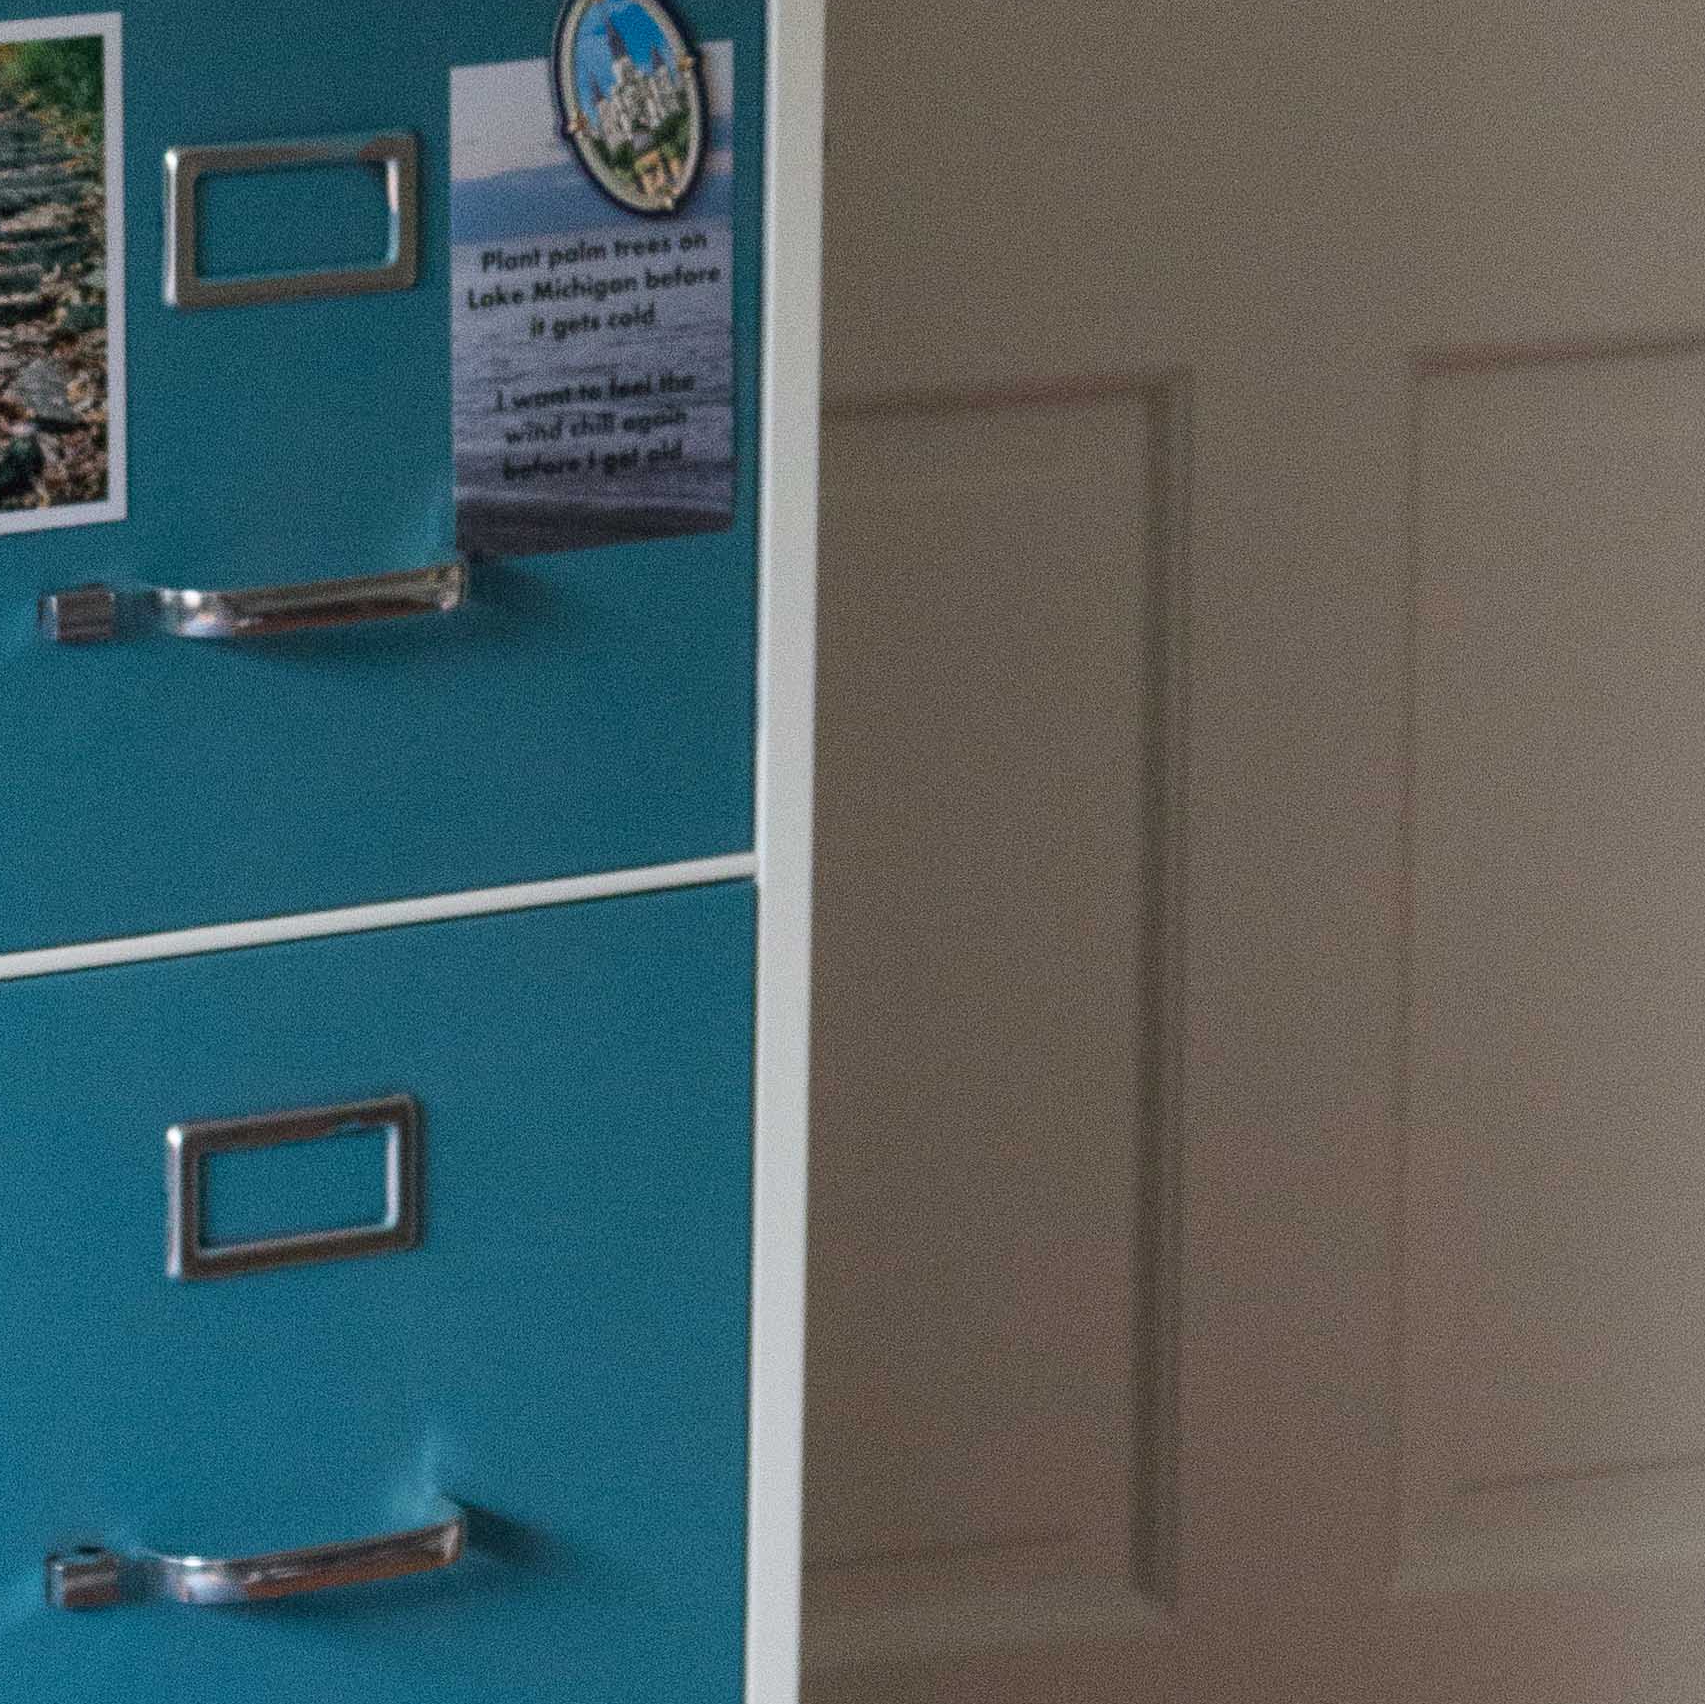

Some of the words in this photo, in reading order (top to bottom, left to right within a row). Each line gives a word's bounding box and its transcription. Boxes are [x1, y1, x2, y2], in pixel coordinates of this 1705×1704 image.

[482, 249, 540, 272] Plant
[549, 240, 606, 269] palm
[614, 236, 670, 256] trees
[679, 233, 706, 251] on
[468, 286, 523, 310] Lake
[533, 275, 637, 301] Michigan
[645, 265, 720, 289] before
[530, 316, 544, 337] it
[553, 314, 600, 340] gets
[608, 303, 655, 328] cold
[512, 388, 570, 407] want
[579, 383, 601, 400] to
[610, 375, 651, 397] feel
[660, 372, 695, 392] the
[506, 414, 562, 442] wind
[571, 412, 613, 436] chill
[623, 407, 687, 433] again
[503, 453, 579, 480] before
[604, 447, 637, 475] get
[648, 438, 682, 461] old
